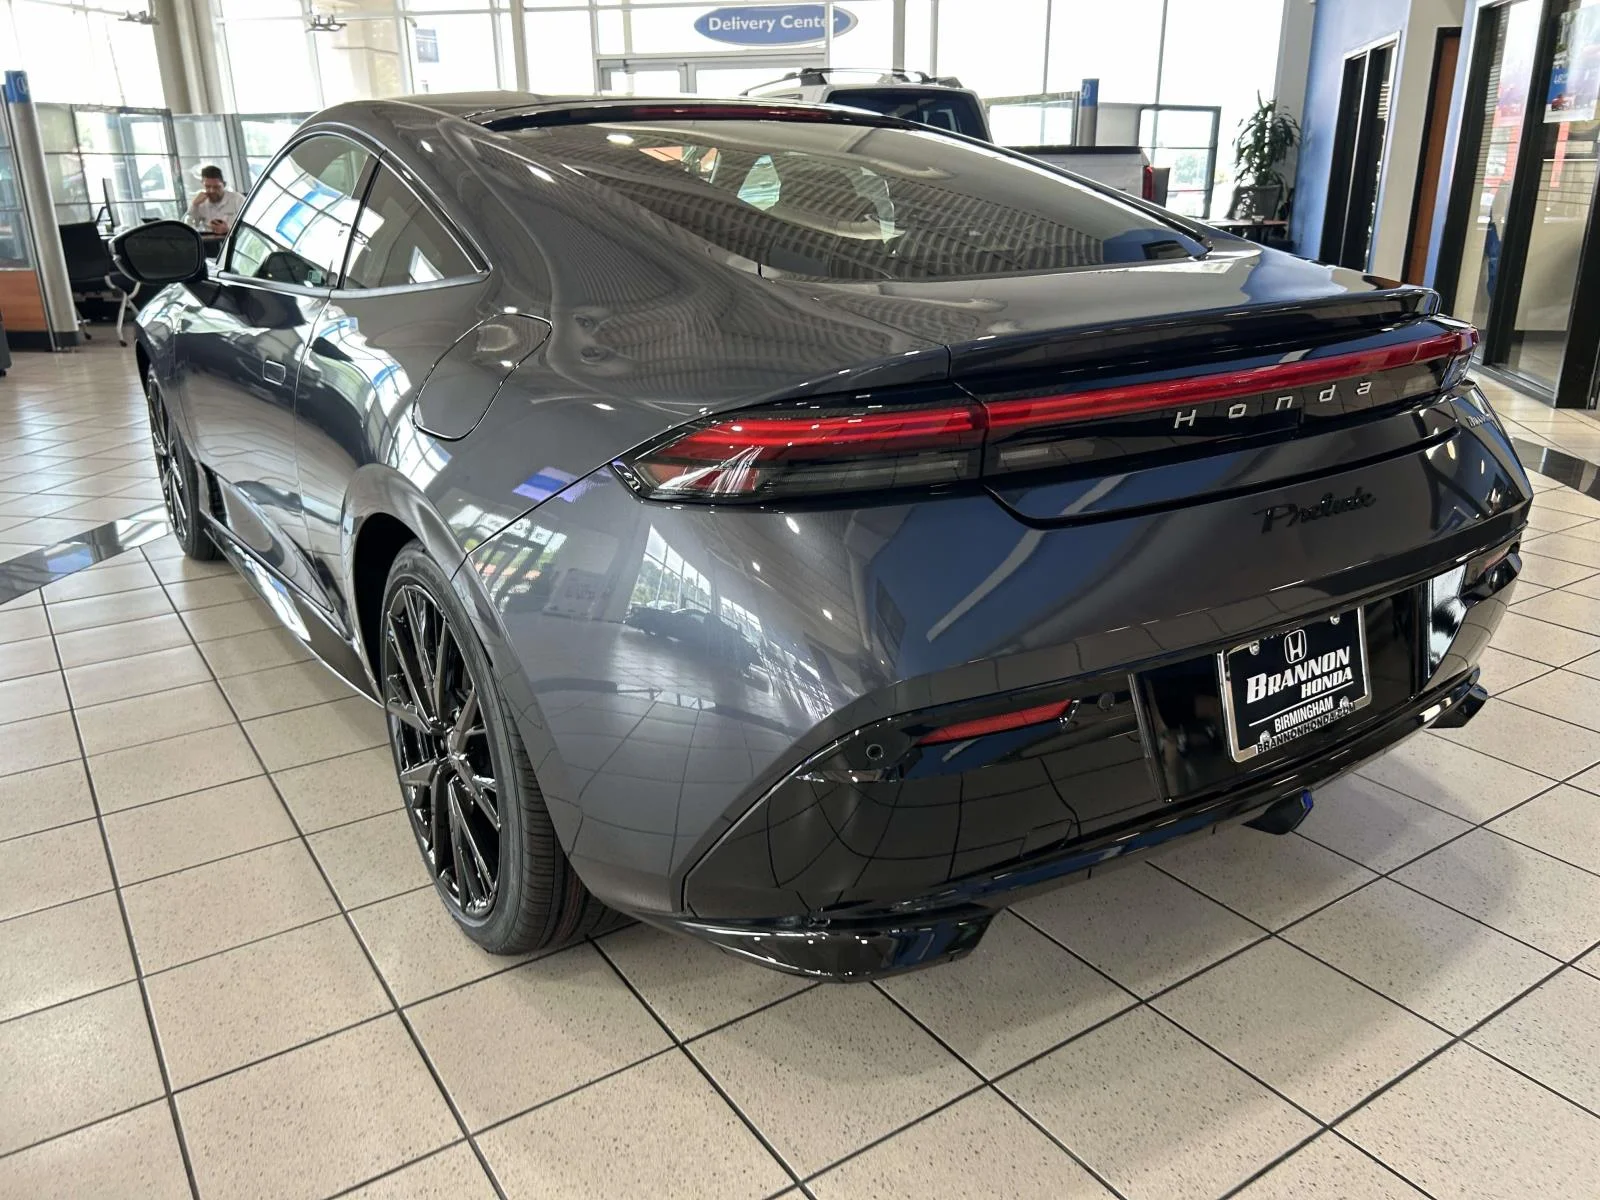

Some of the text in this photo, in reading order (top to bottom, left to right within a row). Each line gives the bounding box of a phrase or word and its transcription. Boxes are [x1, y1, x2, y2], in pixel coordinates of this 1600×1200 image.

[708, 16, 776, 33] Delivery
[1301, 667, 1353, 699] HONDA
[1274, 696, 1334, 733] BIRMINGHAM
